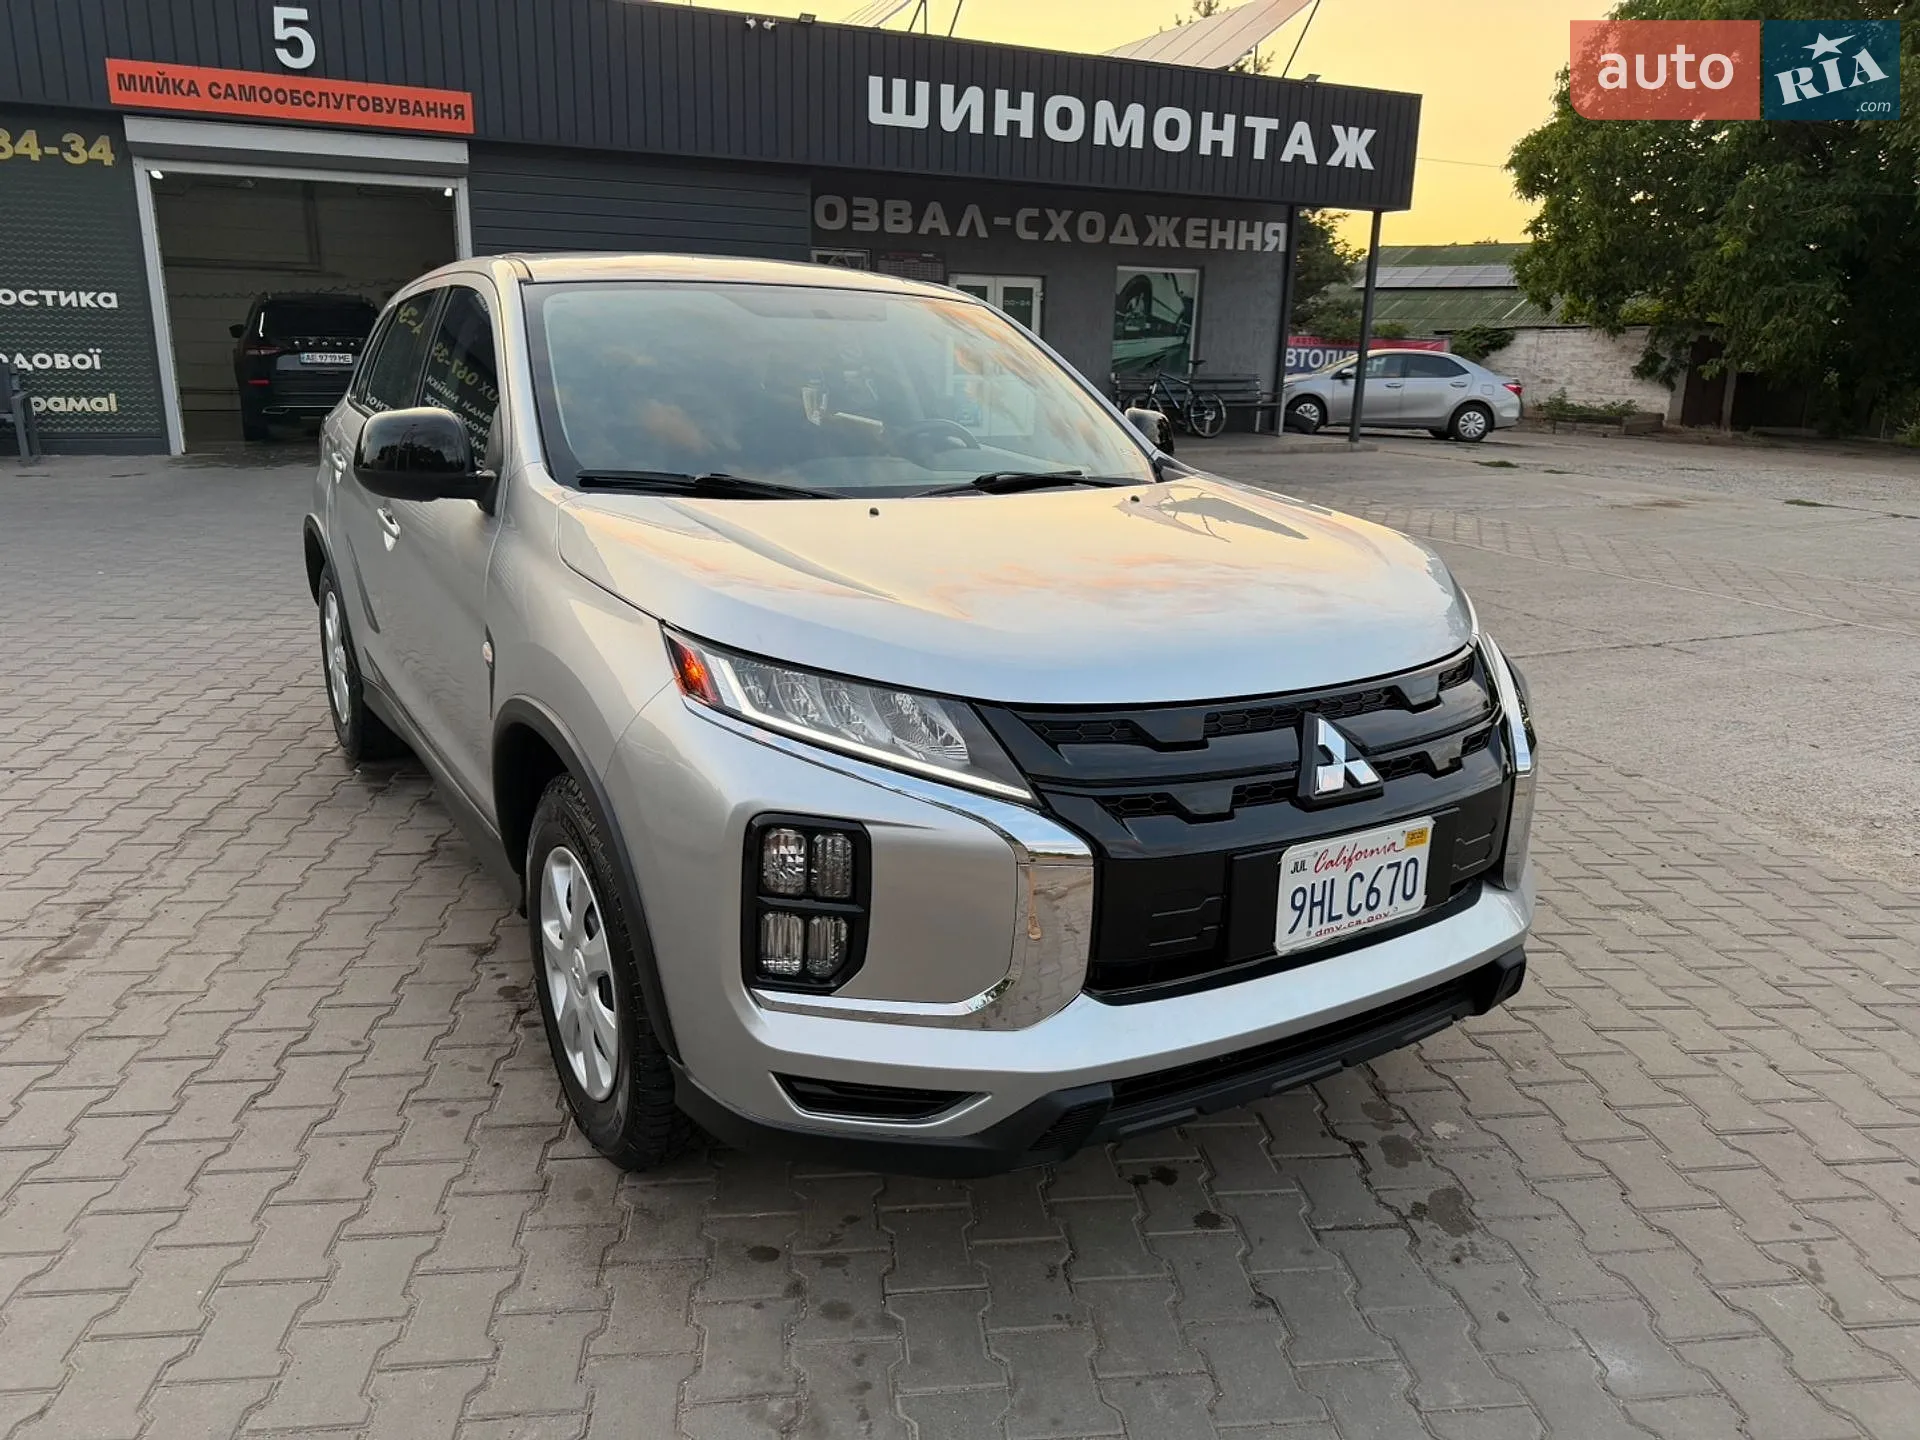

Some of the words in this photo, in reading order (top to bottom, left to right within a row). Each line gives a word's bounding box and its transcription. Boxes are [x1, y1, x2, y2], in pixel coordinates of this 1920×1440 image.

[273, 6, 316, 69] 5
[116, 71, 201, 99] МИЙКА
[207, 81, 466, 121] САМООБСЛУГОВУВАННЯ
[867, 75, 1377, 171] ШИНОМОНТАЖ
[813, 194, 1287, 252] ОЗВАЛ-СХОДЖЕННЯ
[1290, 859, 1308, 875] JUL
[1314, 841, 1406, 874] California
[1288, 857, 1419, 934] 9HLC670
[1315, 911, 1391, 937] dmv.ca.gov
